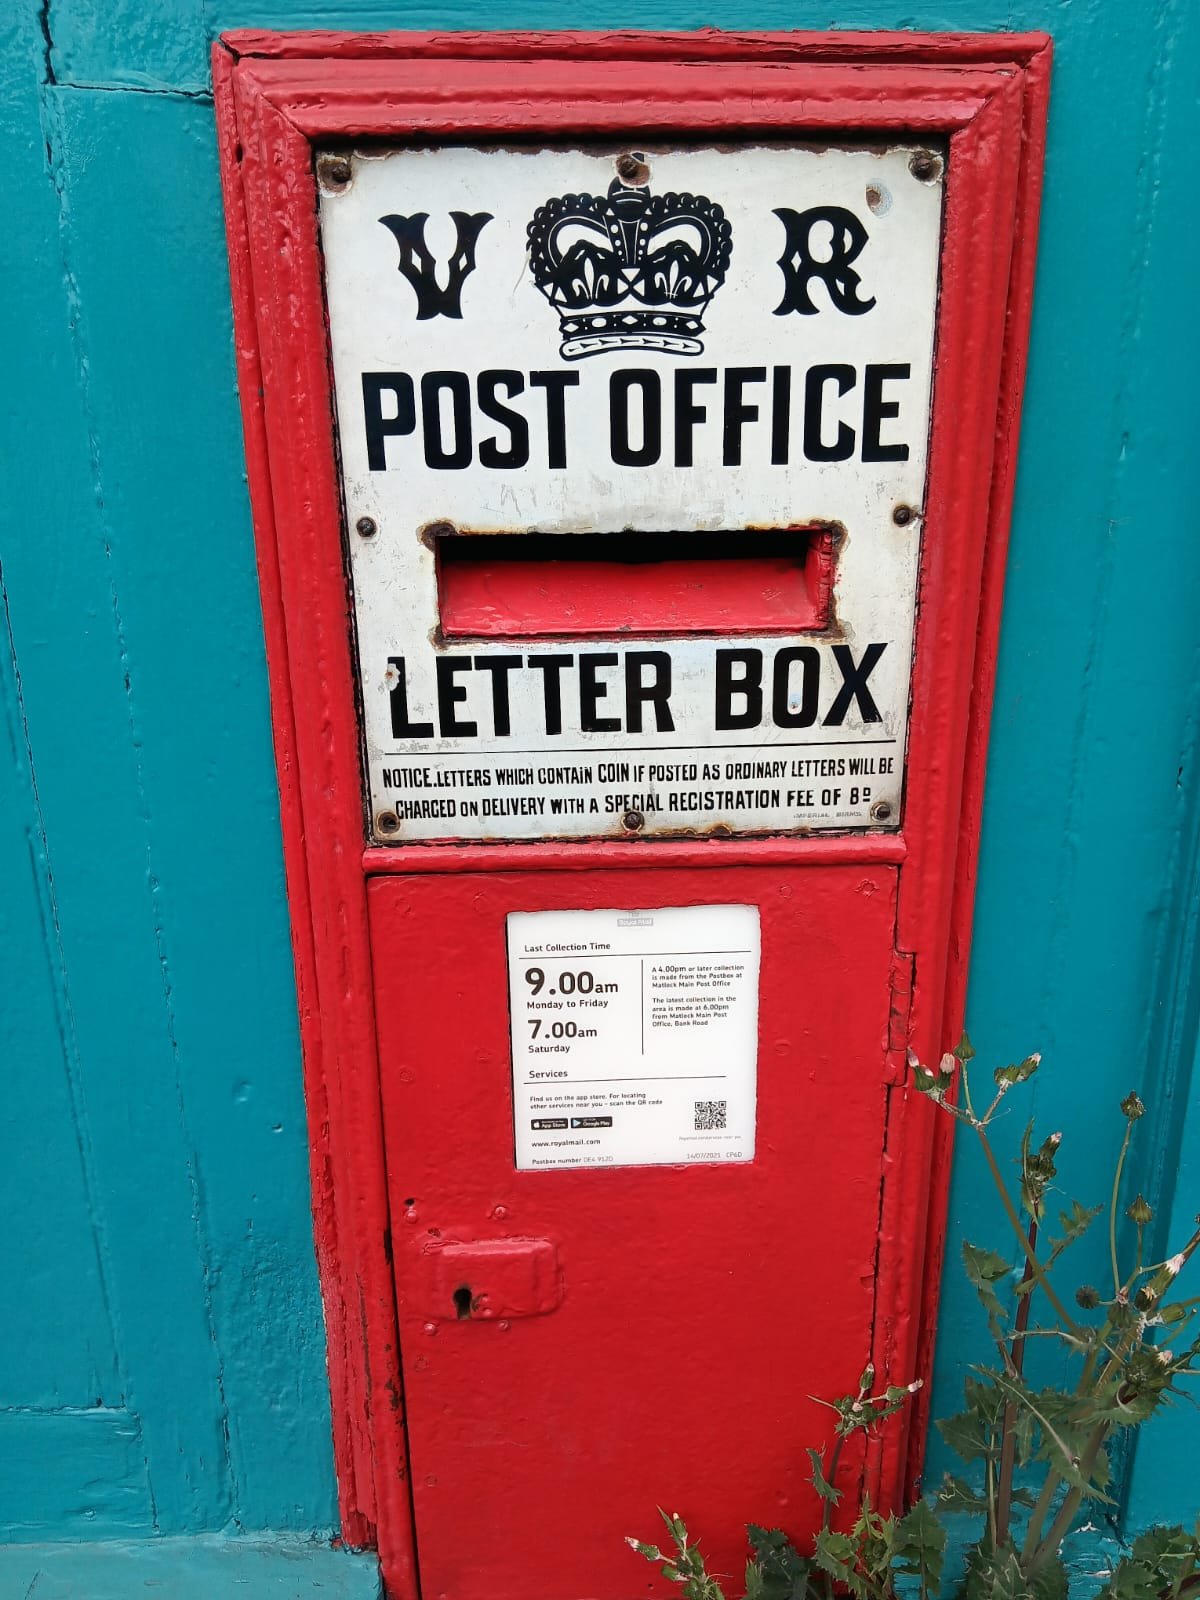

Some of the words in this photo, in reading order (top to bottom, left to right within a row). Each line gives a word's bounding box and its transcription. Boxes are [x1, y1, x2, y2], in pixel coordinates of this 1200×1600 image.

[377, 211, 494, 320] V
[772, 206, 877, 316] R
[361, 369, 580, 472] POST
[609, 364, 911, 468] OFFICE
[388, 650, 676, 739] LETTER
[714, 642, 889, 731] BOX
[496, 768, 534, 786] WHICH
[538, 766, 592, 784] CONTAIN
[599, 763, 630, 783] COIN
[634, 765, 645, 782] IF
[650, 764, 697, 782] POSTED
[702, 763, 720, 780] AS
[726, 760, 787, 780] ORDINARY
[792, 758, 845, 777] LETTERS
[850, 758, 875, 776] WILL
[879, 758, 894, 774] BE
[396, 799, 456, 820] CHARGED
[460, 802, 478, 816] ON
[482, 797, 546, 816] DELIVERY
[550, 798, 584, 815] WITH
[590, 798, 598, 814] A
[605, 793, 664, 812] SPECIAL
[669, 789, 780, 812] REGISTRATION
[786, 790, 814, 806] FEE
[822, 788, 842, 806] OF
[524, 944, 543, 952] Last
[546, 943, 587, 952] Collection
[525, 968, 618, 996] 9.00am
[527, 1000, 563, 1009] Monday
[580, 1000, 608, 1008] Friday
[528, 1019, 598, 1039] 7.00am
[528, 1044, 570, 1053] Saturday
[529, 1070, 568, 1078] Services
[532, 1138, 601, 1148] www.royalmail.com
